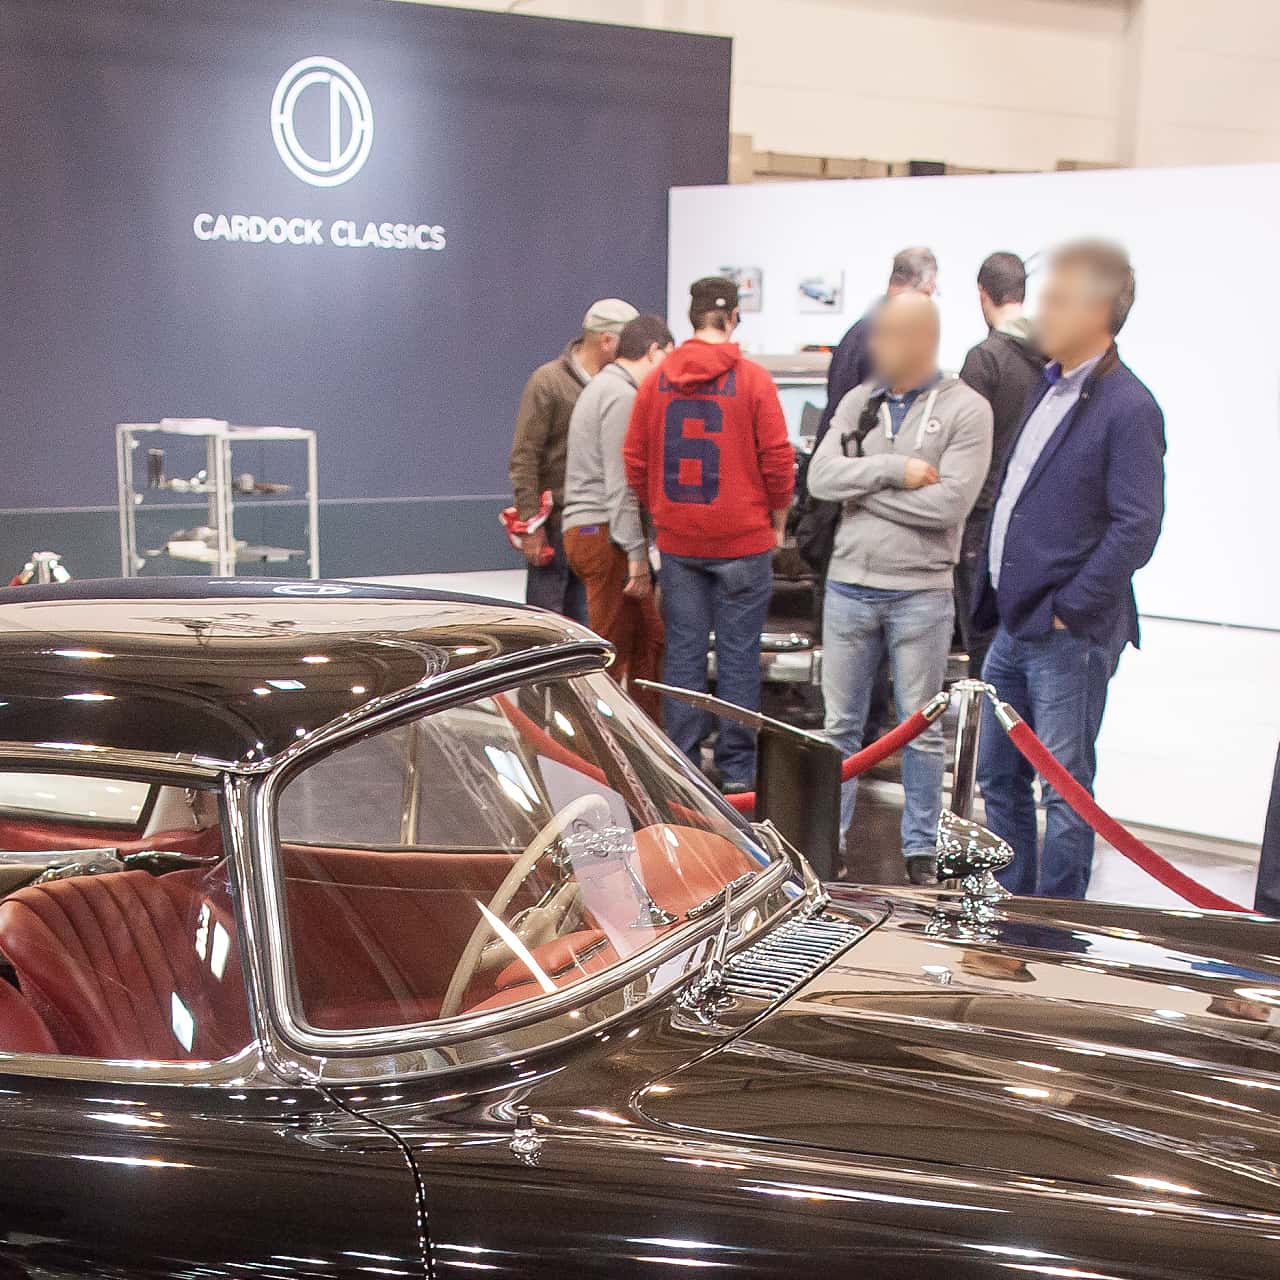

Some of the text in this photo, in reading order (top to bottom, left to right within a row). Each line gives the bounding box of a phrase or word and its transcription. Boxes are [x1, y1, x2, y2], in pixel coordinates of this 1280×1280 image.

[193, 213, 447, 250] CARDOCK CLASSICS
[663, 399, 724, 504] 6
